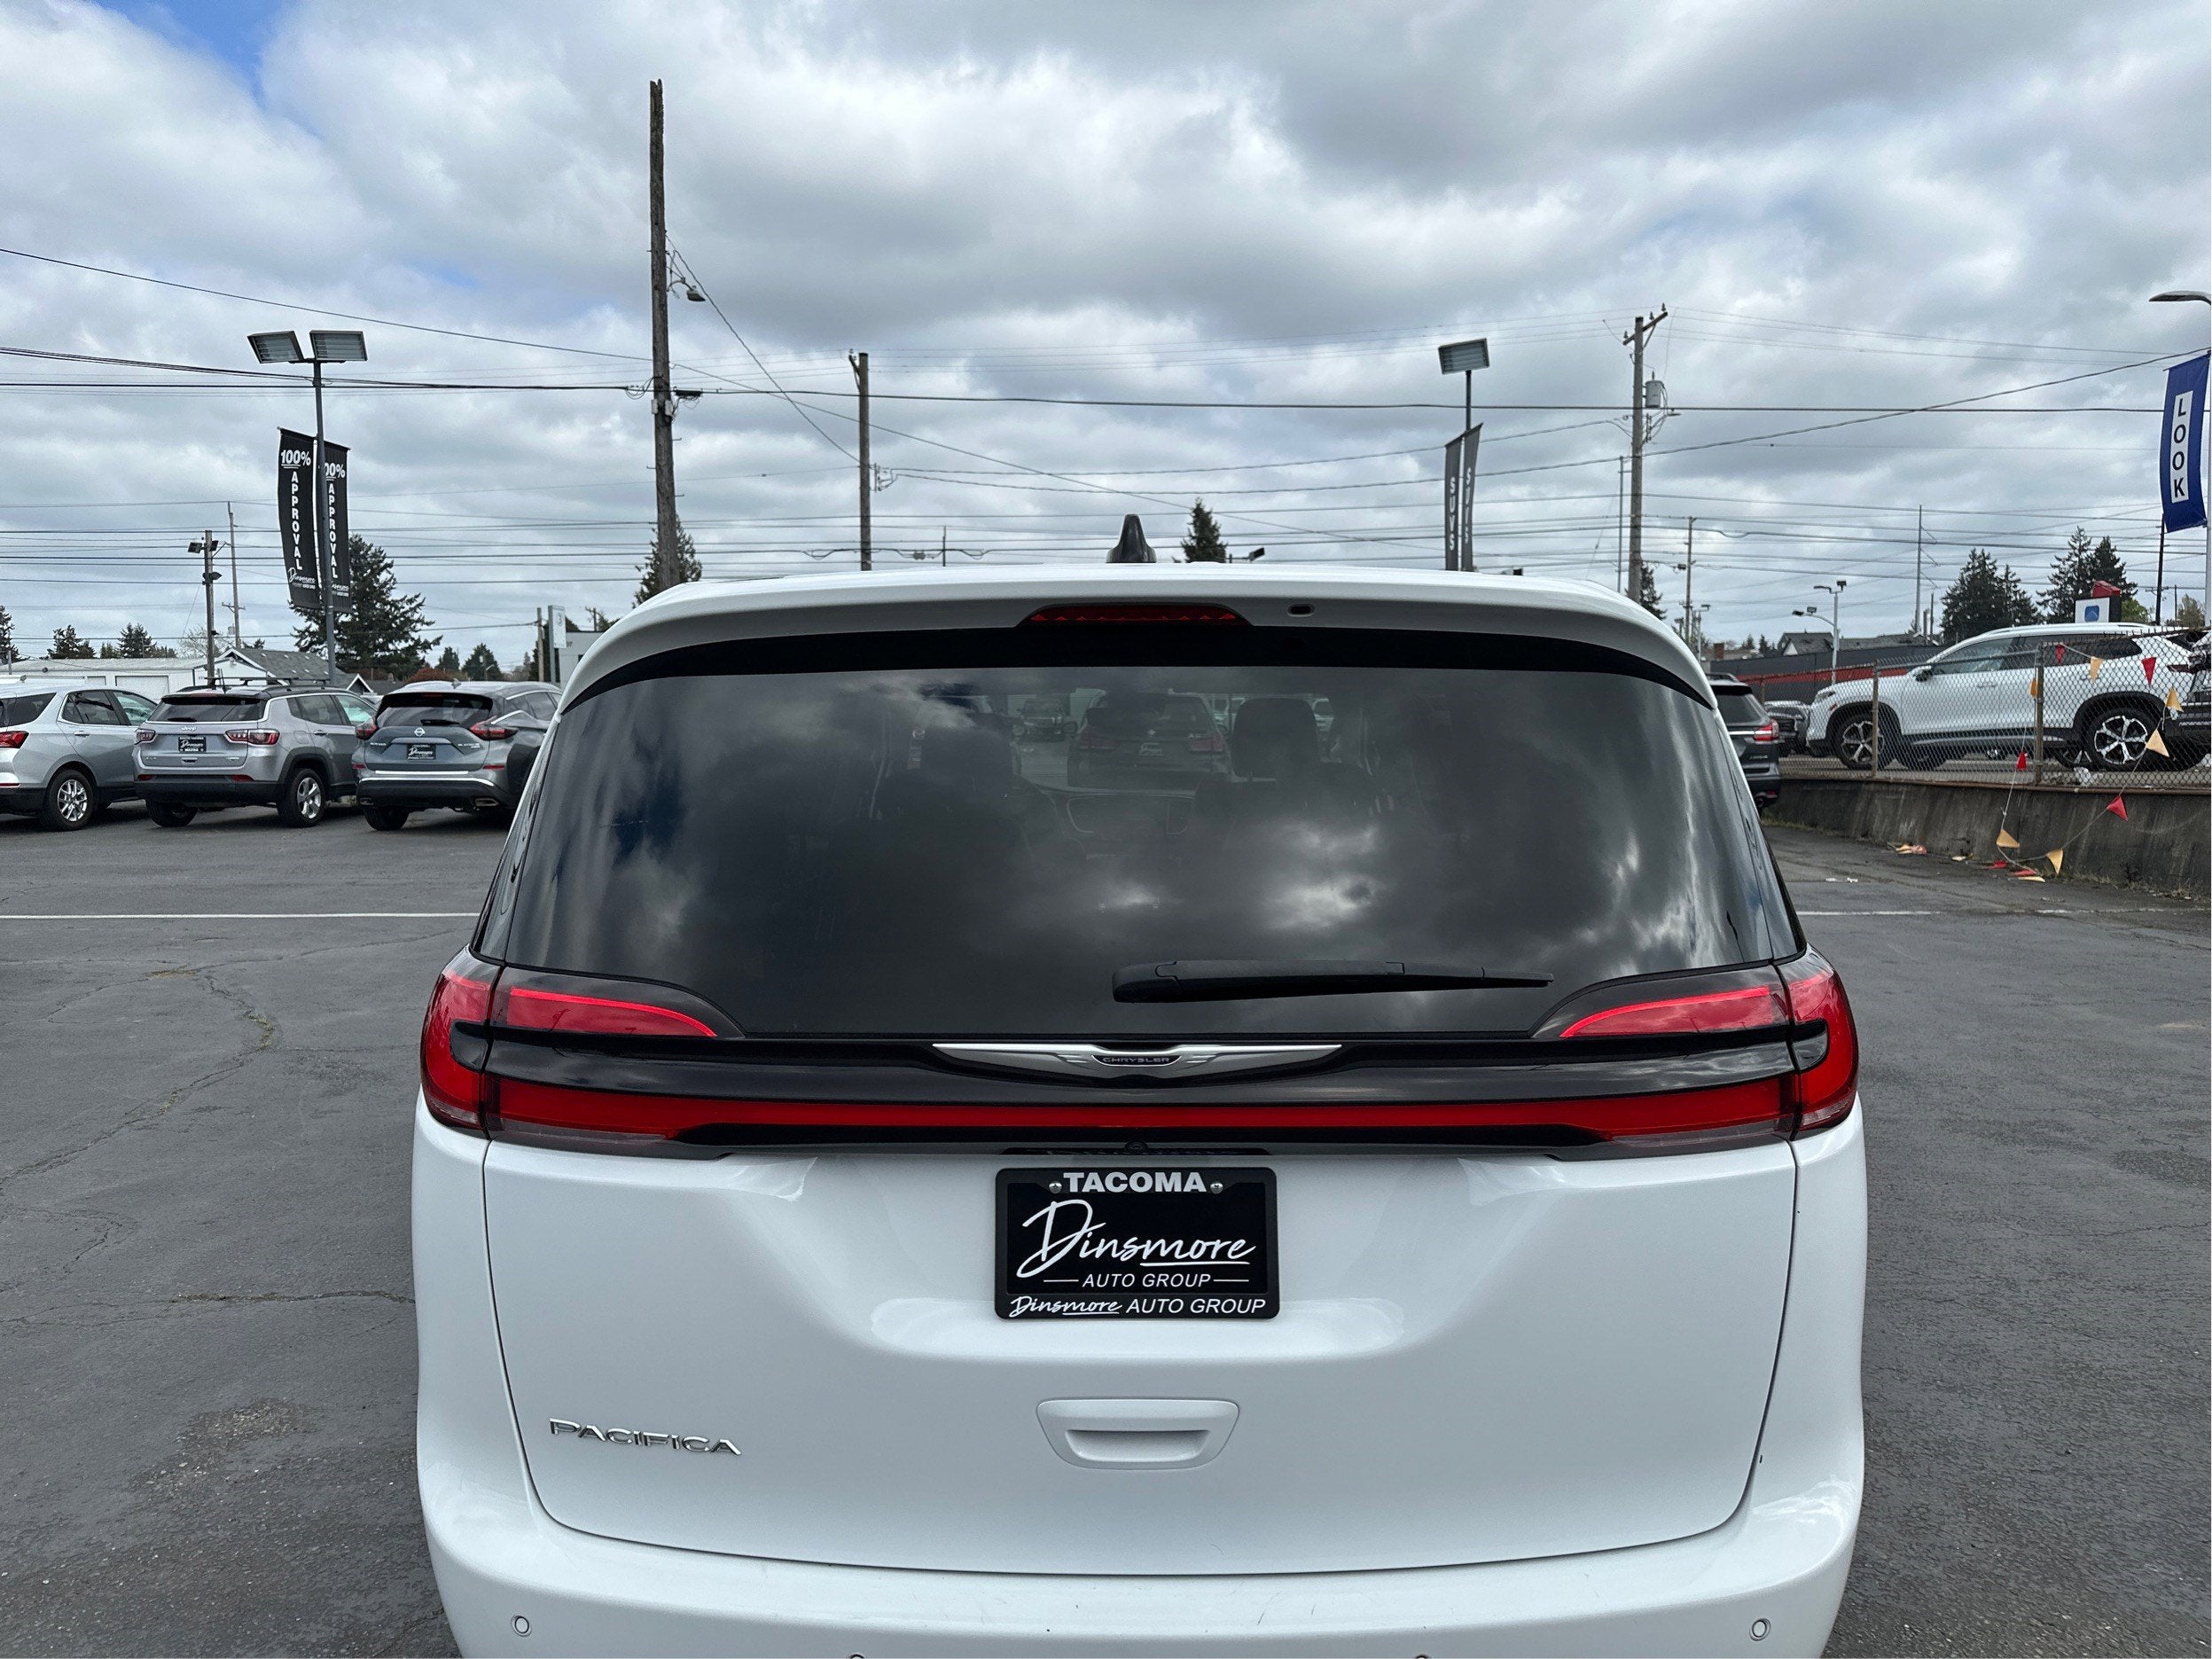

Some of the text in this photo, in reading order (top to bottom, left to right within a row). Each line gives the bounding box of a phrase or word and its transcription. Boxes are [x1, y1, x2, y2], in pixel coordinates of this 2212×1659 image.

[280, 450, 311, 466] 100%
[2172, 397, 2187, 498] LOOK
[324, 462, 346, 478] 00%
[291, 471, 303, 571] APPROVAL
[328, 482, 339, 579] APPROVAL
[1063, 1171, 1207, 1193] TACOMA
[1016, 1199, 1256, 1278] Dinsmore
[1082, 1273, 1211, 1288] AUTO GROUP
[1008, 1295, 1267, 1319] Dinsmore AUTO GROUP
[549, 1417, 742, 1456] PACIFICA
